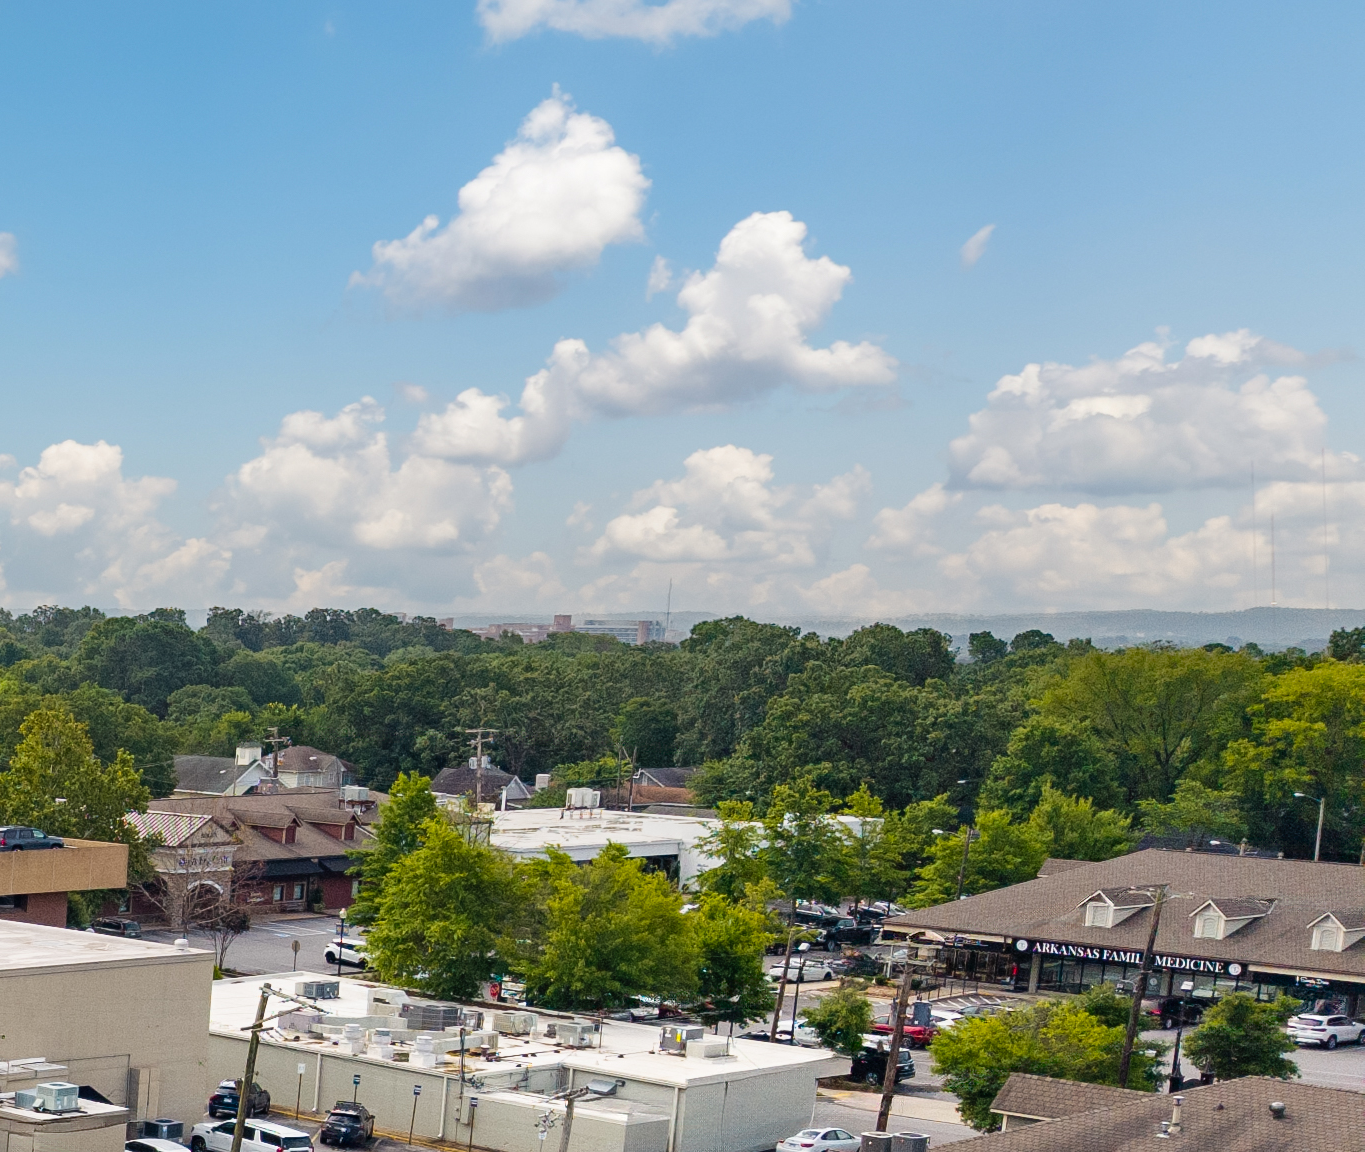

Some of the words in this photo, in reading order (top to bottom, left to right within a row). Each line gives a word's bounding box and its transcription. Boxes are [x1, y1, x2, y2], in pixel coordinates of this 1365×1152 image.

[1033, 942, 1100, 959] ARKANSAS
[1102, 949, 1147, 964] FAMIL
[1154, 955, 1224, 973] MEDICINE
